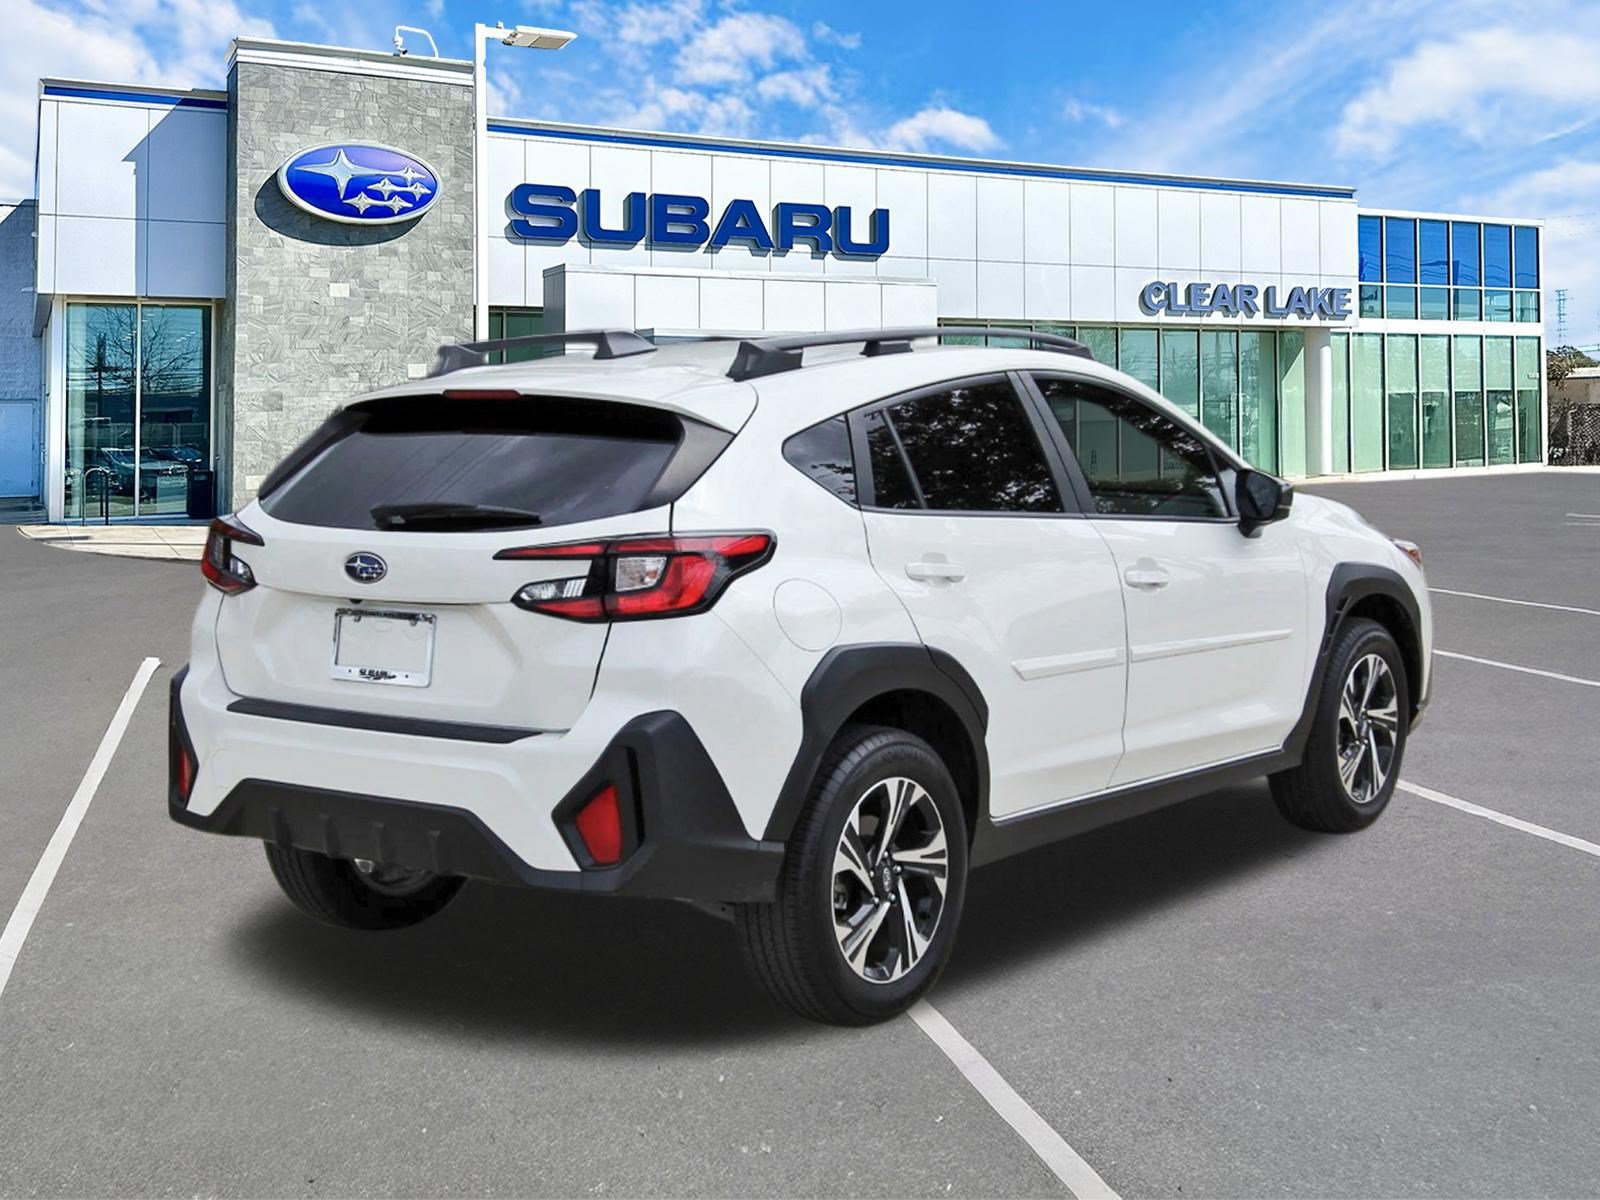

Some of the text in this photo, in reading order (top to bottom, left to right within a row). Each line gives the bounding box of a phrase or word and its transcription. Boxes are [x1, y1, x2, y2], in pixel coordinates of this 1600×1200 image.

[507, 183, 889, 259] SUBARU
[1141, 281, 1352, 319] CLEAR LAKE
